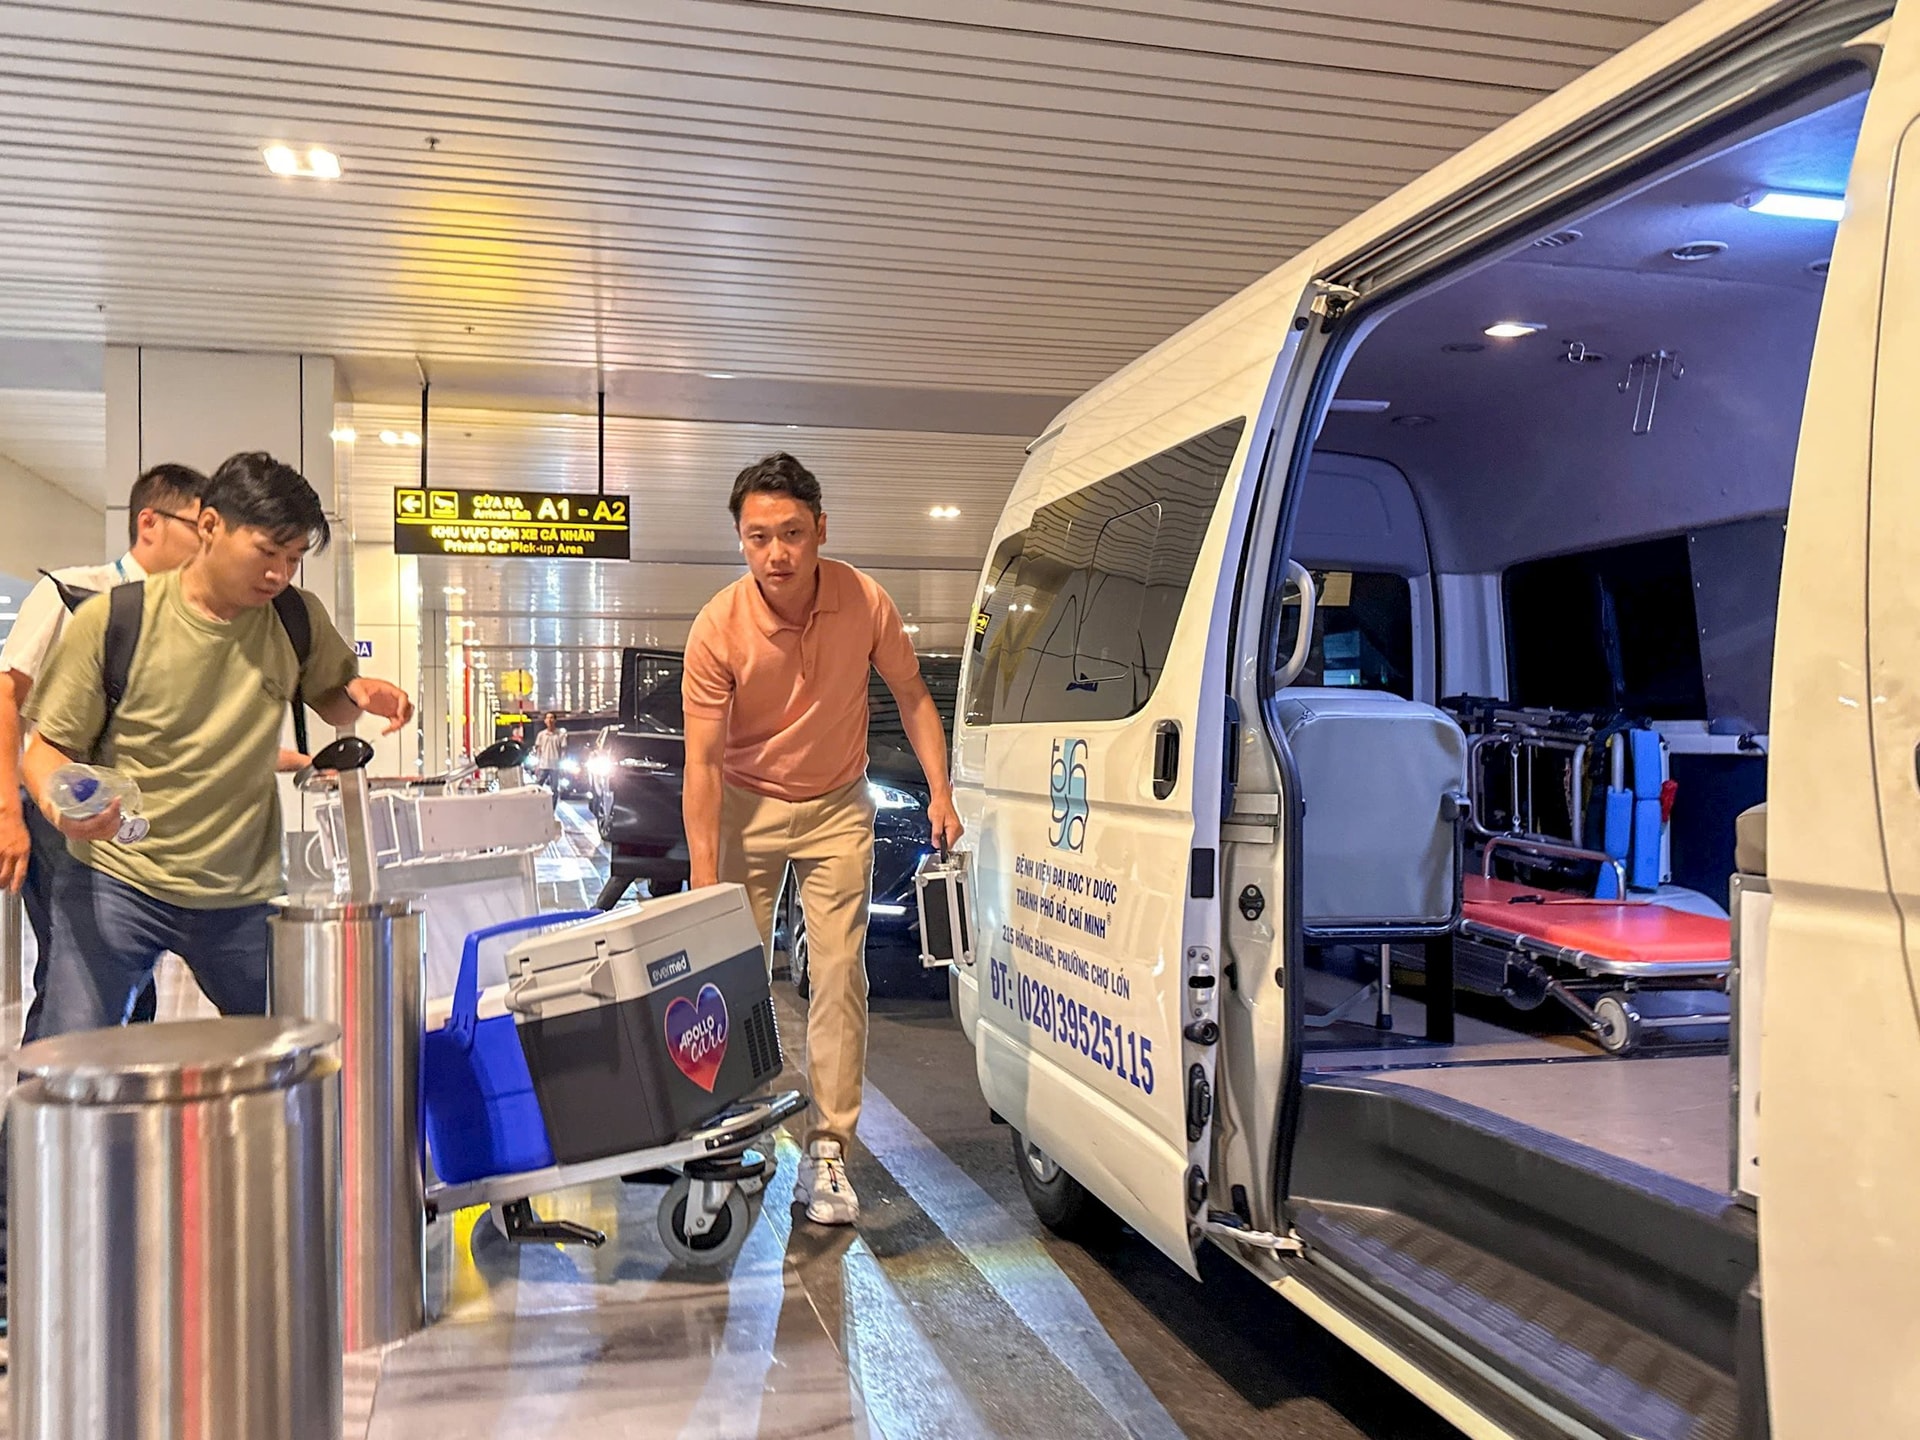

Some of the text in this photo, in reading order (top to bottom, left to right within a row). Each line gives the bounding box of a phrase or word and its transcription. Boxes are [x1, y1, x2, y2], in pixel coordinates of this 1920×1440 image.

[504, 496, 524, 510] RA
[537, 498, 570, 520] A1
[592, 501, 626, 521] A2
[431, 525, 460, 539] KHU
[461, 526, 490, 541] VỰC
[520, 528, 538, 541] XE
[540, 528, 559, 541] CÁ
[560, 528, 595, 543] NHÂN
[443, 539, 584, 556] Private Car Pick-up Area
[1015, 853, 1117, 907] BỆNH VIỆN ĐẠI HỌC Y DƯỢC
[1016, 887, 1039, 913] THÀNH
[1040, 894, 1054, 919] PHỐ
[1056, 897, 1067, 924] HỒ
[1068, 906, 1084, 930] CHÍ
[652, 955, 687, 982] evermed
[1002, 925, 1015, 945] 215
[1057, 949, 1090, 980] PHƯỜNG
[1091, 964, 1110, 995] CHỢ
[1111, 967, 1130, 1000] LỚN
[990, 957, 1013, 1010] ĐT:
[679, 1015, 715, 1052] APOLLO
[691, 1023, 726, 1063] care
